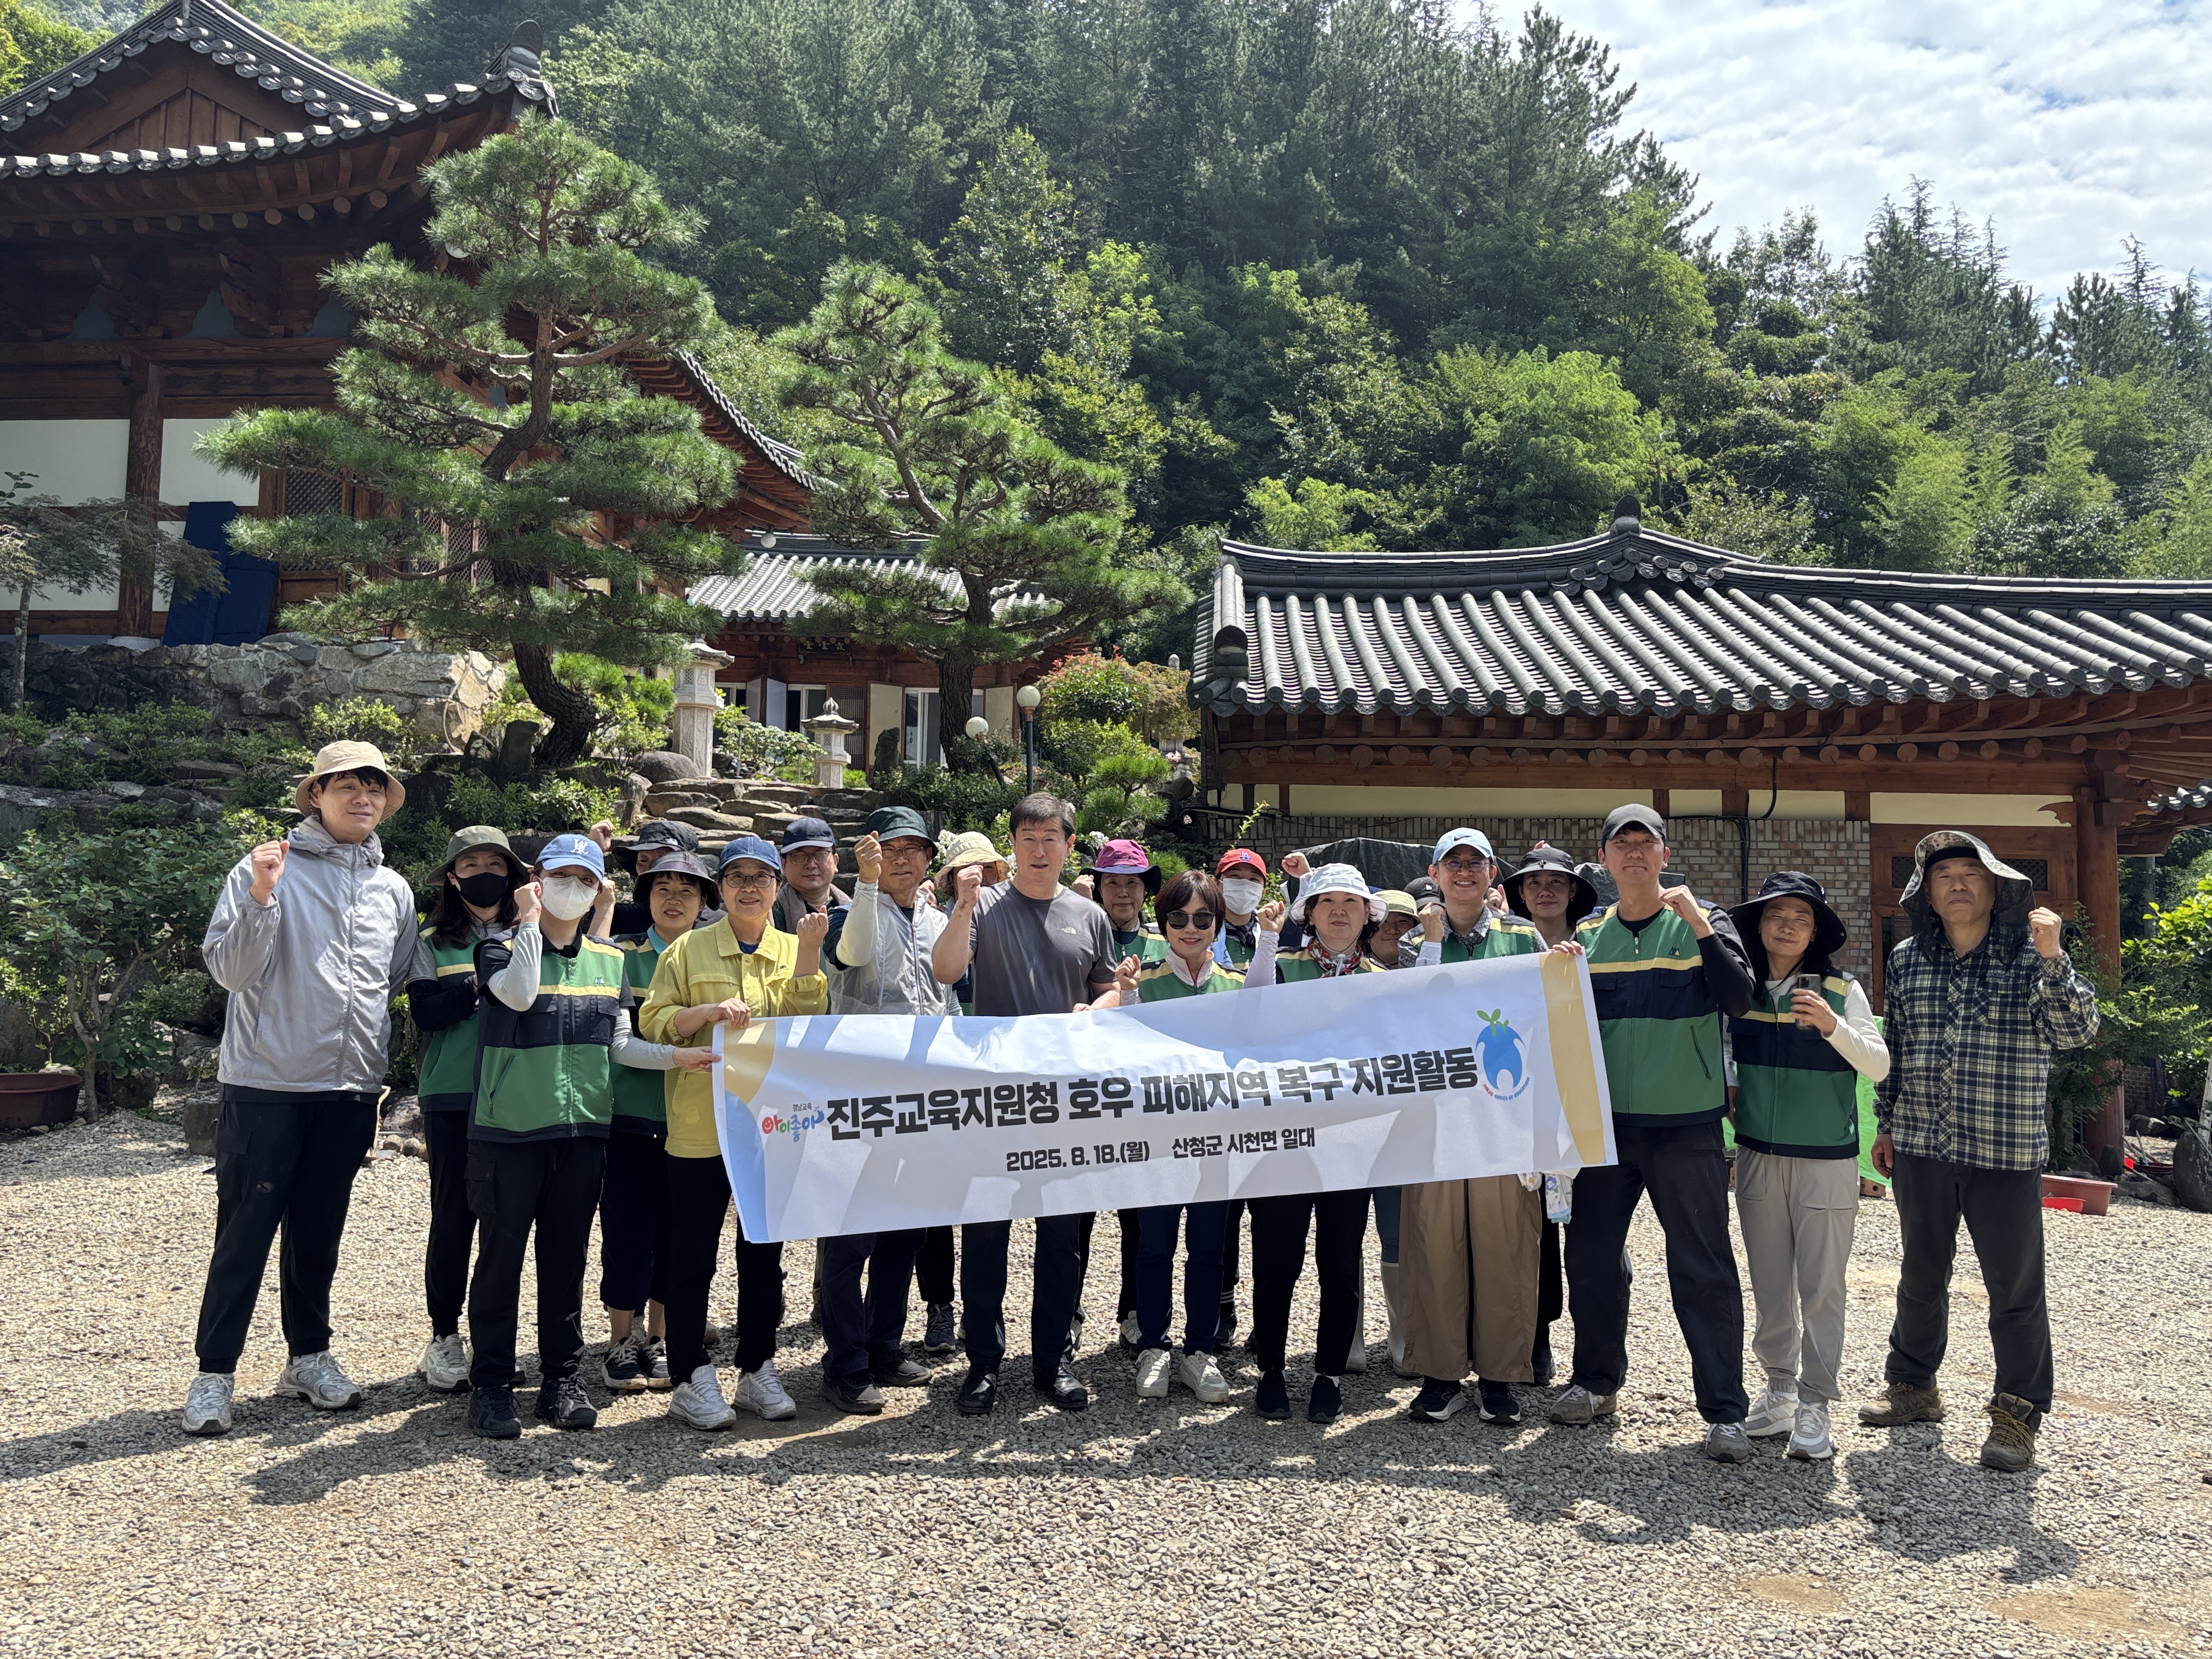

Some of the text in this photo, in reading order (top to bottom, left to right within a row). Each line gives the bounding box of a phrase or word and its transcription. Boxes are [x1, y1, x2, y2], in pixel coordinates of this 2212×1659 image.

[827, 1047, 1478, 1141] 진주교육지원청 호우 피해지역 복구 지원활동
[1514, 1076, 1530, 1098] EDUCATION
[792, 1102, 812, 1112] 경남교육
[761, 1110, 825, 1143] 아이좋아
[1006, 1127, 1316, 1172] 2025. 8. 18.(월) 산청군 시천면 일대
